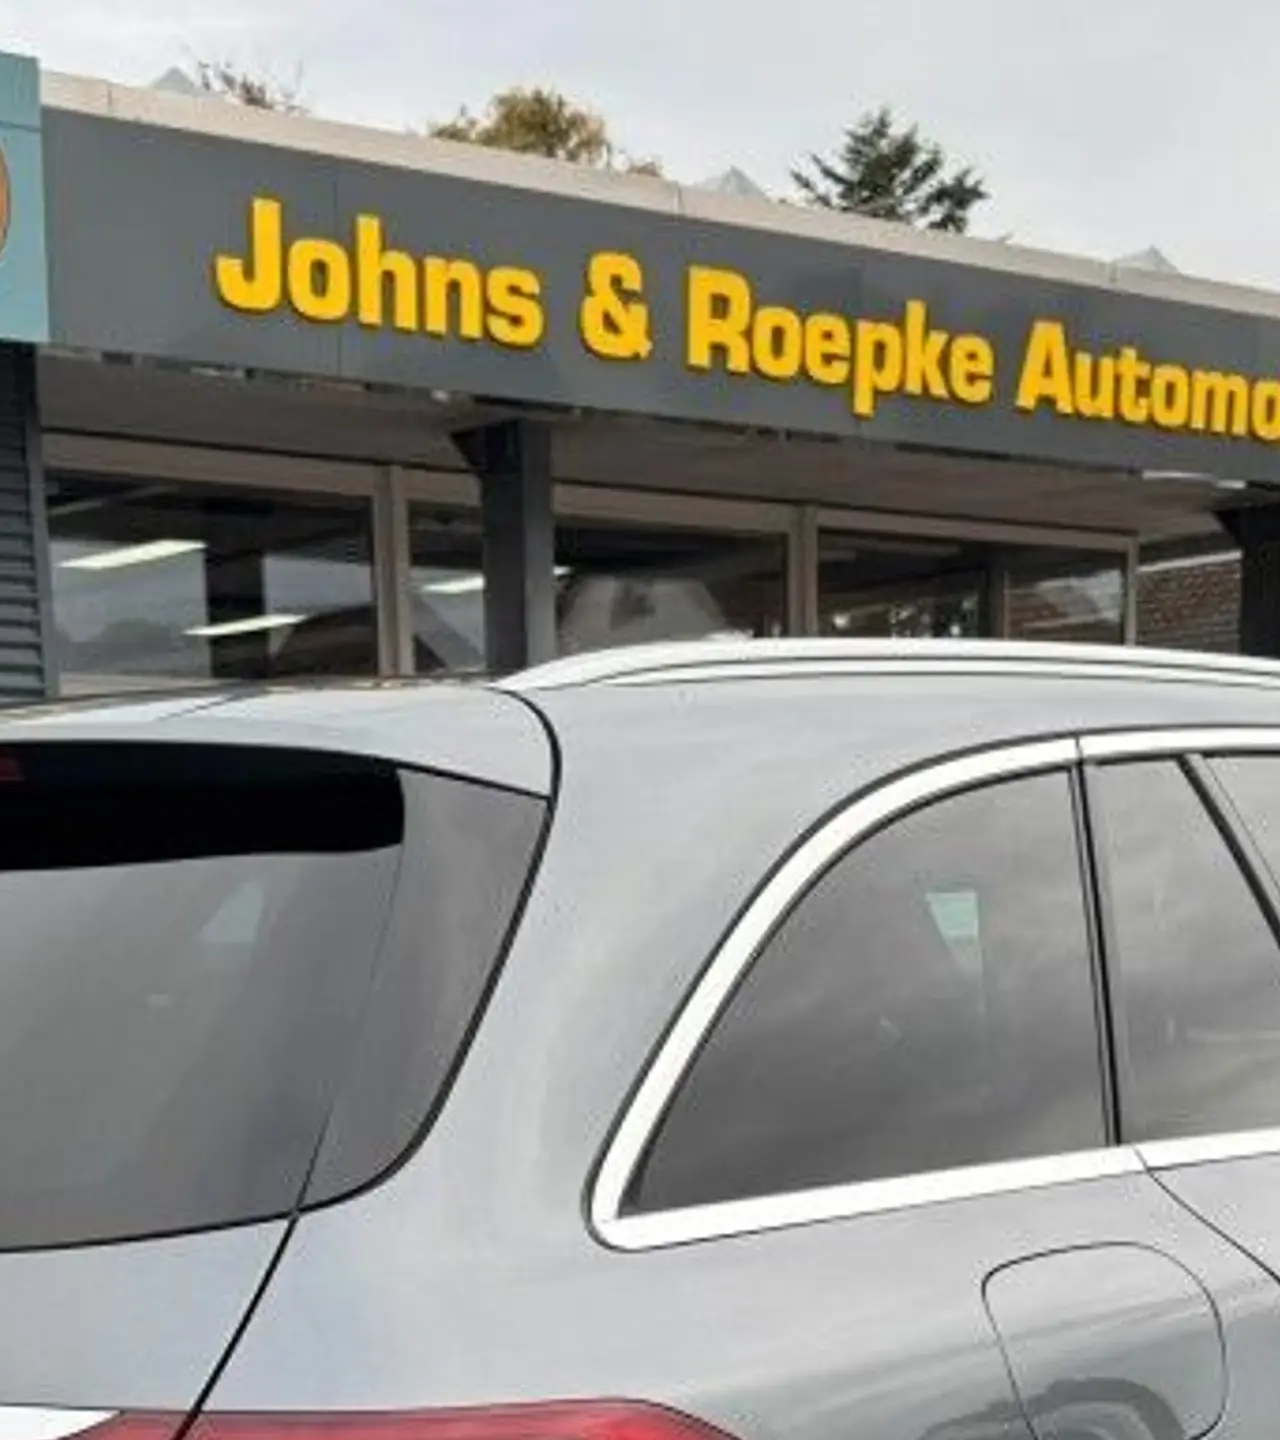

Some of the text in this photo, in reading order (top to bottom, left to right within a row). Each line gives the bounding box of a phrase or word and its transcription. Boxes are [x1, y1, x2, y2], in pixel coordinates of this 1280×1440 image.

[214, 196, 544, 349] Johns
[580, 250, 653, 360] &
[685, 265, 994, 416] Roepke
